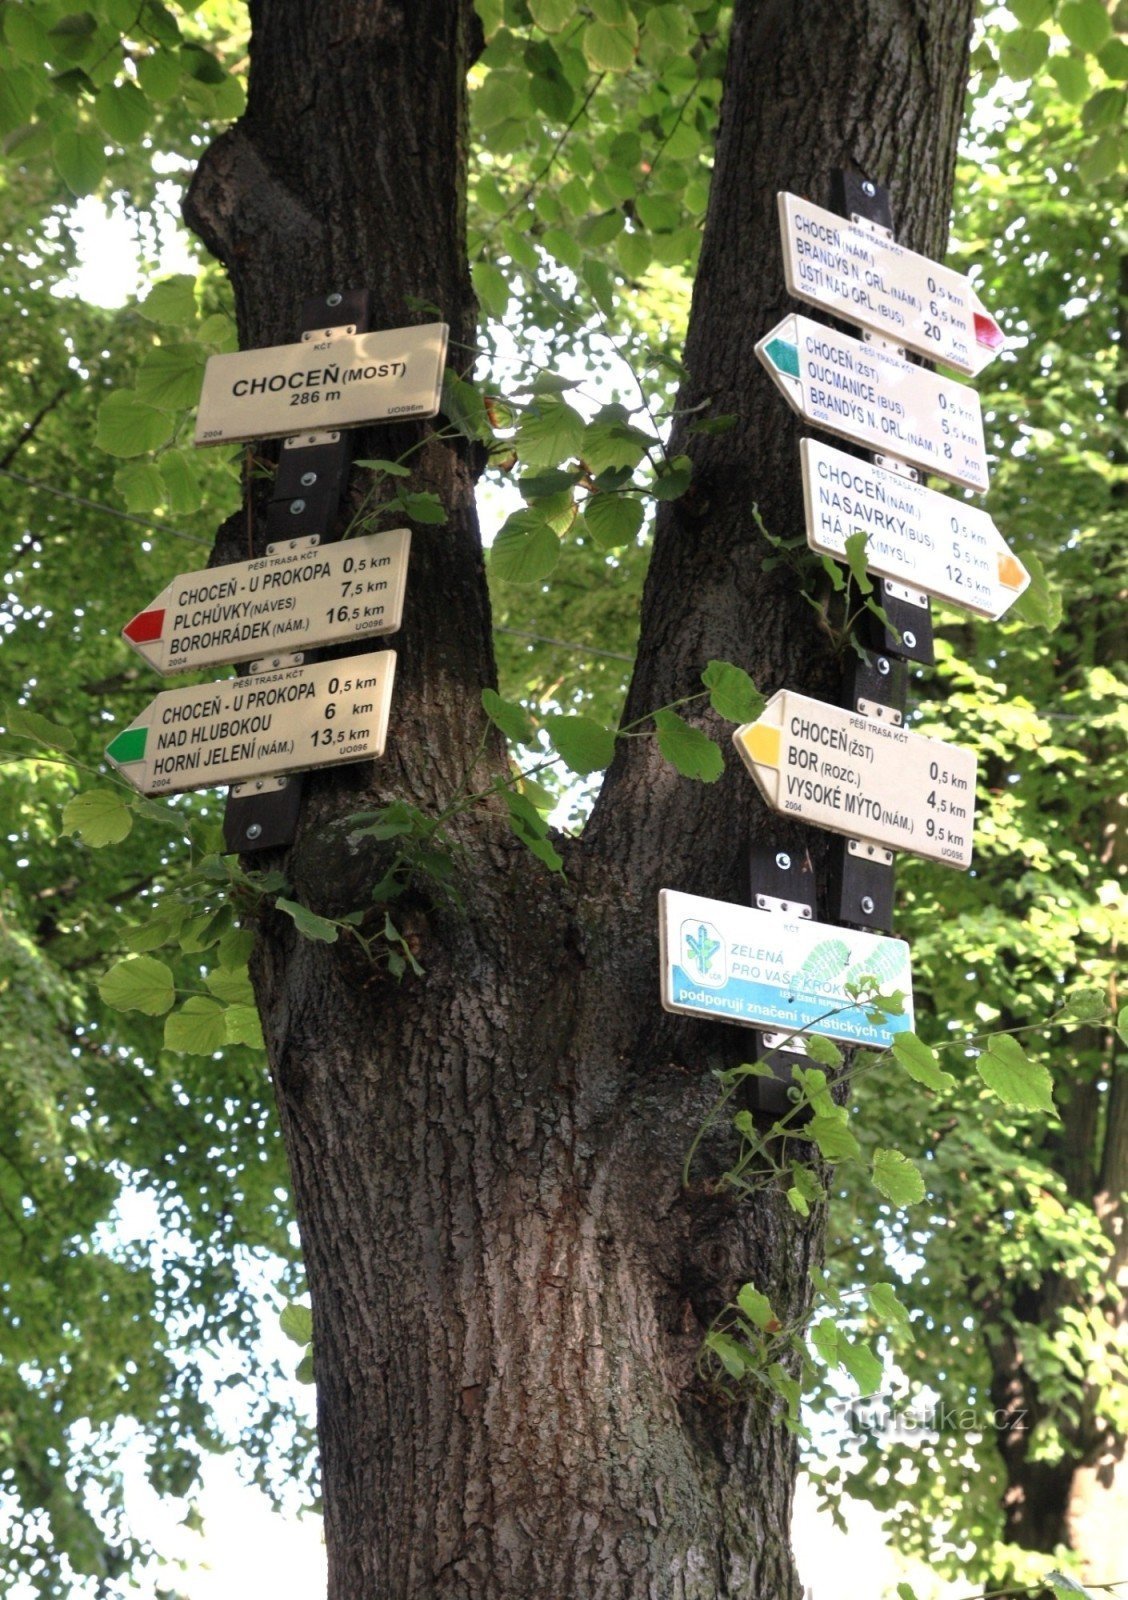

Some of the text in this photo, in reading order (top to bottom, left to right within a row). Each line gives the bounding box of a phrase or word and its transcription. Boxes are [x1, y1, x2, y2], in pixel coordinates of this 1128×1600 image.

[796, 237, 850, 276] BRANDÝS
[950, 312, 966, 330] km
[799, 260, 824, 286] ÚSTÍ
[826, 274, 849, 298] NAD
[923, 322, 941, 342] 20
[952, 338, 968, 354] km
[314, 342, 332, 351] KČT
[232, 363, 340, 396] CHOCEŇ
[290, 391, 340, 406] 286 m
[808, 362, 875, 402] OUCMANICE
[962, 430, 978, 446] km
[959, 406, 974, 422] km
[203, 430, 222, 438] 2004
[810, 388, 864, 424] BRANDÝS
[944, 443, 952, 460] 8
[964, 456, 980, 470] km
[970, 530, 986, 546] km
[270, 555, 298, 566] TRASA
[301, 551, 318, 560] KČT
[974, 555, 990, 571] km
[179, 577, 238, 606] CHOCEŇ
[250, 576, 258, 592] U
[263, 562, 331, 590] PROKOPA
[342, 557, 366, 574] 0,5
[370, 554, 390, 568] km
[341, 581, 362, 598] 7,5
[367, 580, 388, 592] km
[975, 579, 991, 596] km
[170, 604, 384, 654] BOROHRÁDEK (NÁM.) 16,5 km
[168, 658, 186, 667] 2004
[255, 674, 283, 684] TRASA
[286, 669, 304, 679] KČT
[162, 696, 221, 725] CHOCEŇ
[234, 696, 244, 712] U
[247, 682, 316, 708] PROKOPA
[328, 677, 352, 694] 0,5
[356, 676, 376, 690] km
[158, 702, 373, 750] NAD HLUBOKOU 6 km
[868, 724, 892, 738] TRASA
[894, 732, 908, 744] KČT
[154, 727, 370, 775] HORNÍ JELENÍ (NÁM.) 13,5 km
[791, 716, 848, 750] CHOCEŇ
[930, 762, 949, 784] 0,5
[951, 773, 968, 790] km
[152, 778, 171, 788] 2004
[788, 746, 966, 819] BOR (ROZC.) 4,5 km
[785, 800, 802, 812] 2004
[787, 774, 842, 810] VYSOKÉ
[926, 818, 945, 841] 9,5
[948, 830, 964, 847] km
[731, 944, 784, 965] ZELENÁ
[732, 964, 760, 979] PRO
[765, 970, 799, 988] VAŠE
[680, 989, 744, 1011] podporují
[747, 1000, 797, 1022] značení
